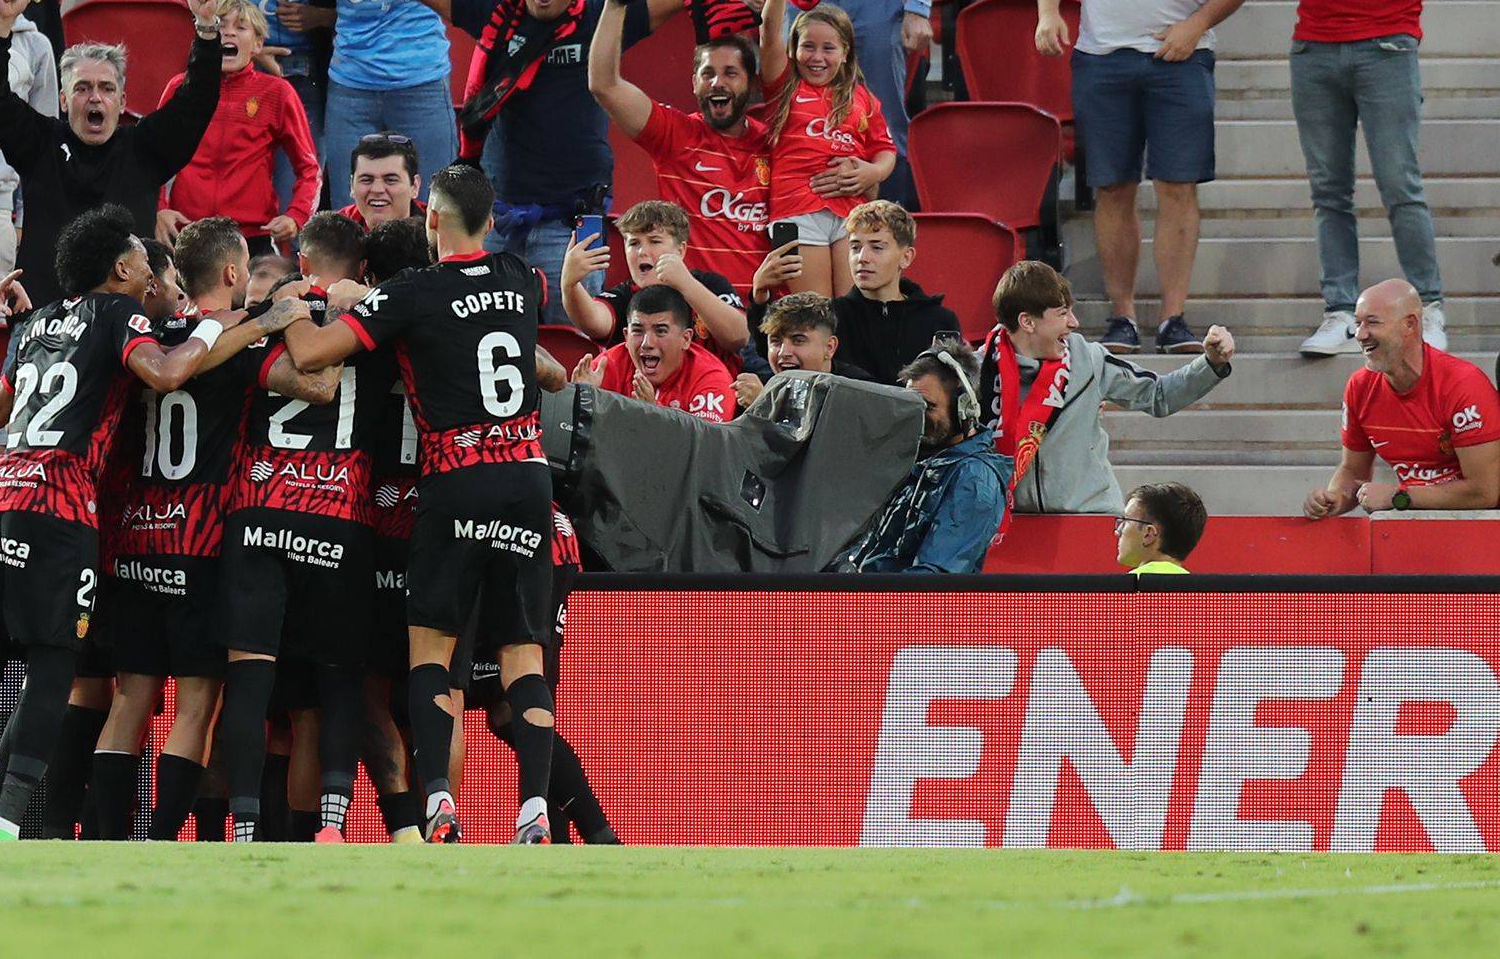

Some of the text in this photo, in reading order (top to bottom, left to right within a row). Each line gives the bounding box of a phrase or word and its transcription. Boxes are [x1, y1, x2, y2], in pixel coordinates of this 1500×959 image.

[737, 221, 750, 233] by
[451, 290, 525, 318] COPETE
[477, 331, 525, 418] 6
[5, 361, 79, 449] 22
[1452, 404, 1482, 429] OK
[141, 389, 199, 481] 10
[279, 462, 349, 486] ALUA
[285, 479, 310, 488] HOTELS
[318, 483, 346, 493] RESORTS
[131, 503, 186, 522] ALUA
[243, 525, 346, 561] Mallorca
[454, 519, 542, 550] Mallorca
[491, 540, 510, 551] Illes
[113, 558, 188, 586] allorca
[287, 551, 340, 570] Illes Balears
